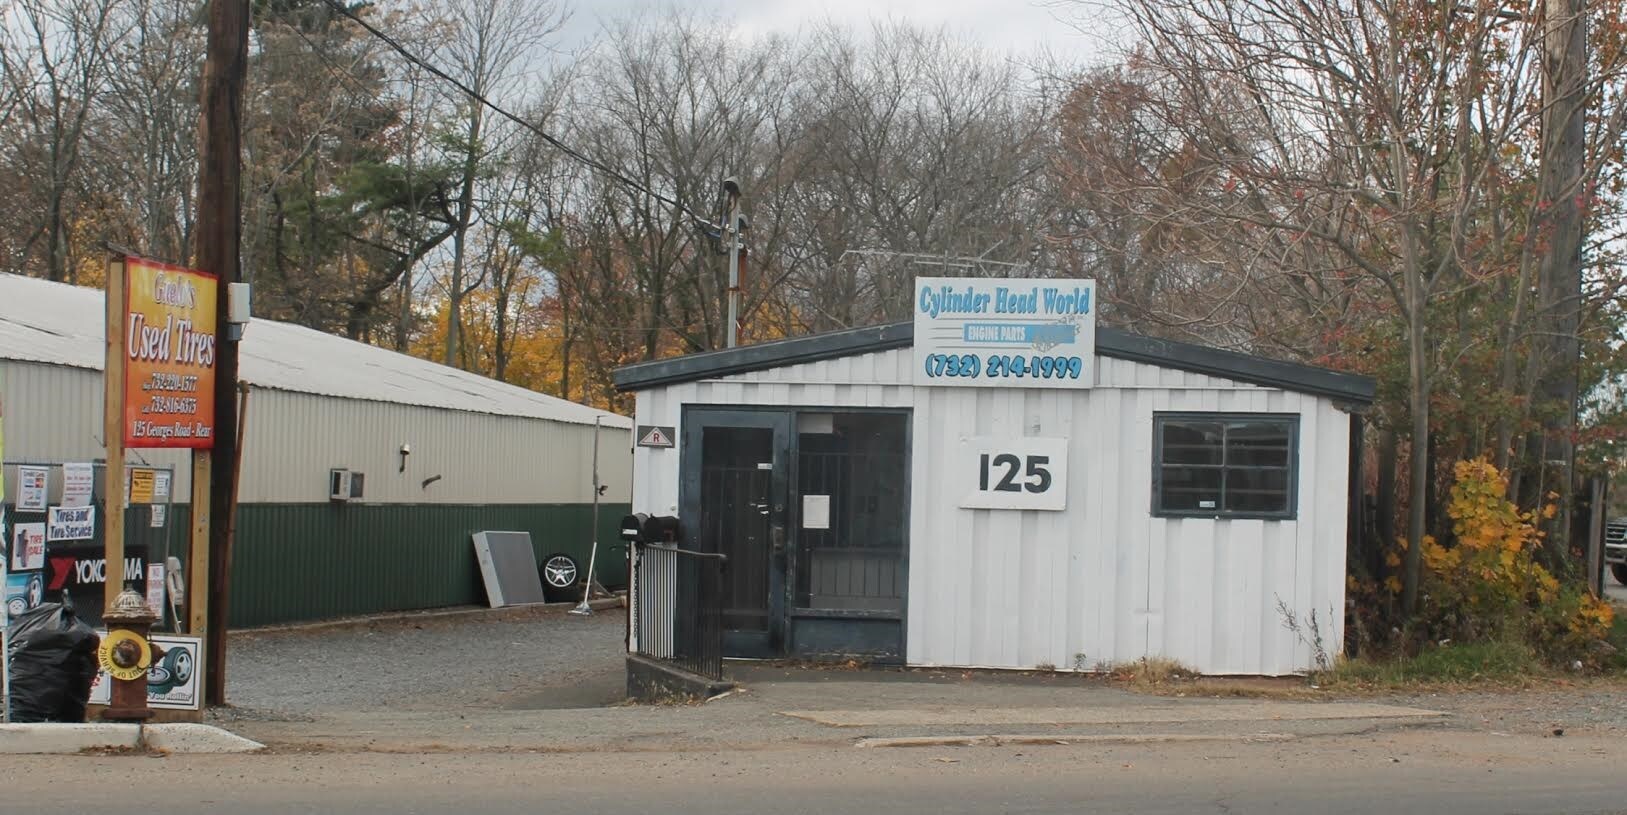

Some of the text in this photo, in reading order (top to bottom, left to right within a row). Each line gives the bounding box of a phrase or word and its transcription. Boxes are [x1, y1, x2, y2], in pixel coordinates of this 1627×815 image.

[919, 286, 1090, 318] Cylinder Head World
[129, 313, 214, 365] Used Tires
[968, 326, 1026, 341] ENGINE PARTS
[925, 354, 1082, 379] (732) 214-1999
[133, 420, 146, 436] 125
[174, 421, 192, 437] Road
[196, 423, 211, 437] Rear
[653, 432, 660, 442] R
[979, 453, 1052, 493] 125
[56, 509, 75, 523] Tires
[30, 535, 43, 545] TIRE
[51, 525, 92, 539] Tire Service
[75, 557, 143, 584] YOKOMA
